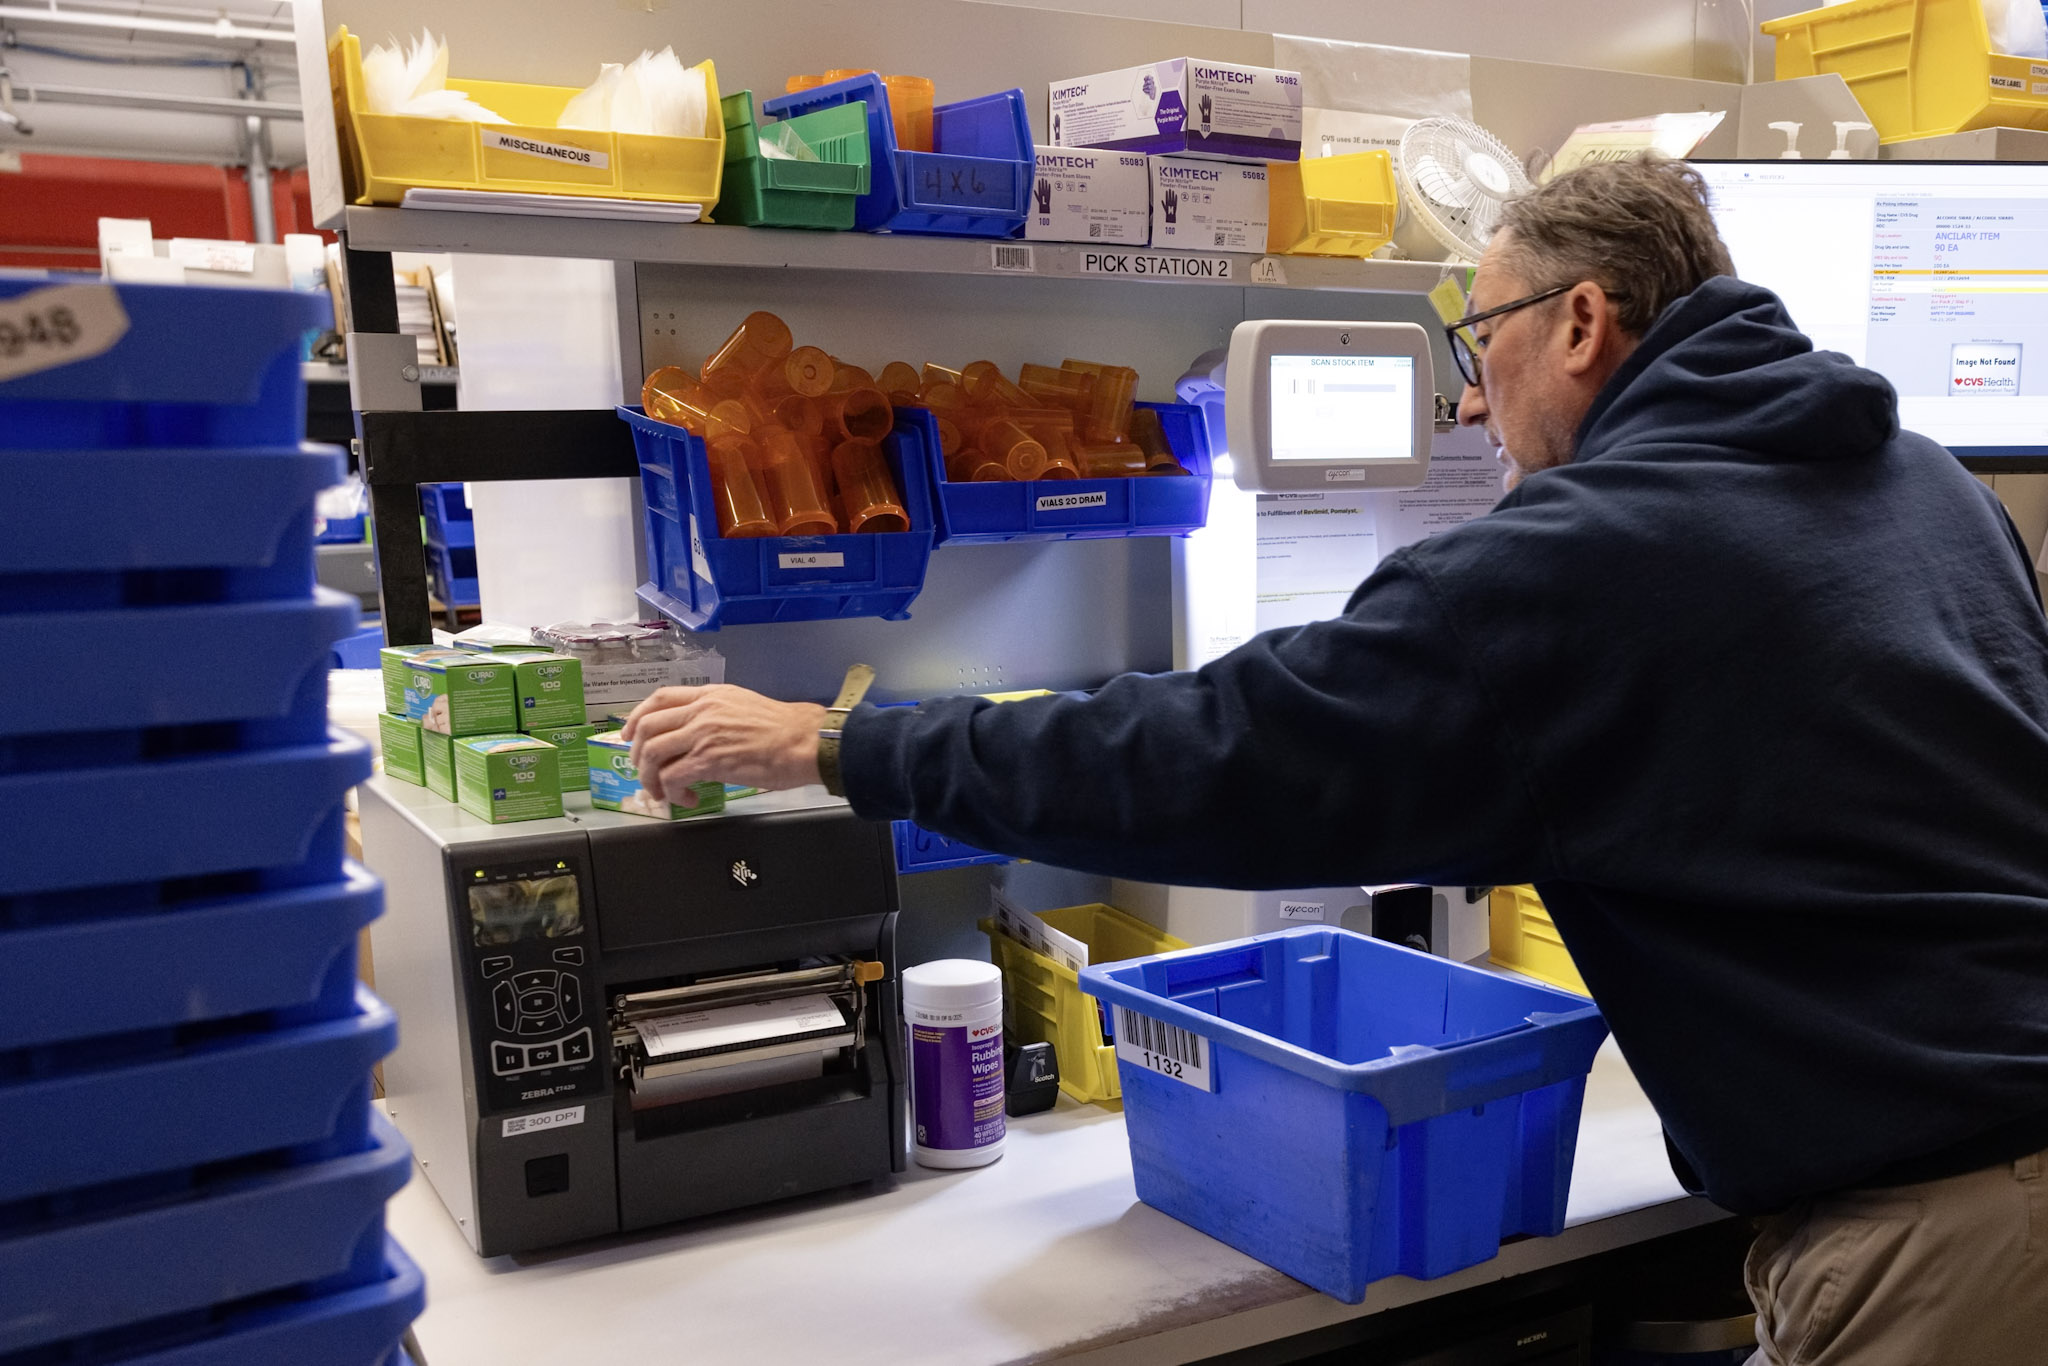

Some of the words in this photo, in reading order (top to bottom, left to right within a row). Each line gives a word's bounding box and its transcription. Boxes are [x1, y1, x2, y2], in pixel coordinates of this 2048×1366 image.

[1275, 75, 1298, 86] 55082
[1200, 124, 1210, 132] 100
[1321, 134, 1334, 142] CVS
[499, 137, 590, 163] MISCELLANEOUS
[1120, 157, 1144, 166] 55083
[1242, 170, 1266, 180] 55082
[925, 167, 942, 198] 4
[970, 167, 986, 194] 6
[1039, 218, 1050, 226] 100
[1165, 227, 1176, 235] 100
[1936, 232, 1978, 240] ANCILARY
[1980, 232, 2000, 240] ITEM
[1934, 244, 1945, 252] 90
[1948, 244, 1958, 252] EA
[1086, 254, 1128, 272] PICK
[1135, 256, 1212, 276] STATION
[1218, 260, 1228, 278] 2
[1956, 358, 1977, 367] Image
[1994, 358, 2016, 366] Found
[1040, 498, 1064, 507] VIALS
[1079, 495, 1104, 504] DRAM
[468, 671, 495, 680] CURAD
[538, 666, 562, 676] CURAD
[541, 681, 560, 689] 100
[552, 732, 576, 741] CURAD
[510, 756, 537, 766] CURAD
[513, 772, 535, 780] 100
[972, 1041, 994, 1050] Isopropyl
[972, 1061, 998, 1074] Wipes
[1144, 1051, 1183, 1079] 1132
[1034, 1073, 1054, 1083] Scotch
[521, 1088, 555, 1100] ZEBRA
[556, 1084, 576, 1092] ZT420
[529, 1116, 551, 1126] 300
[556, 1112, 577, 1122] DPI
